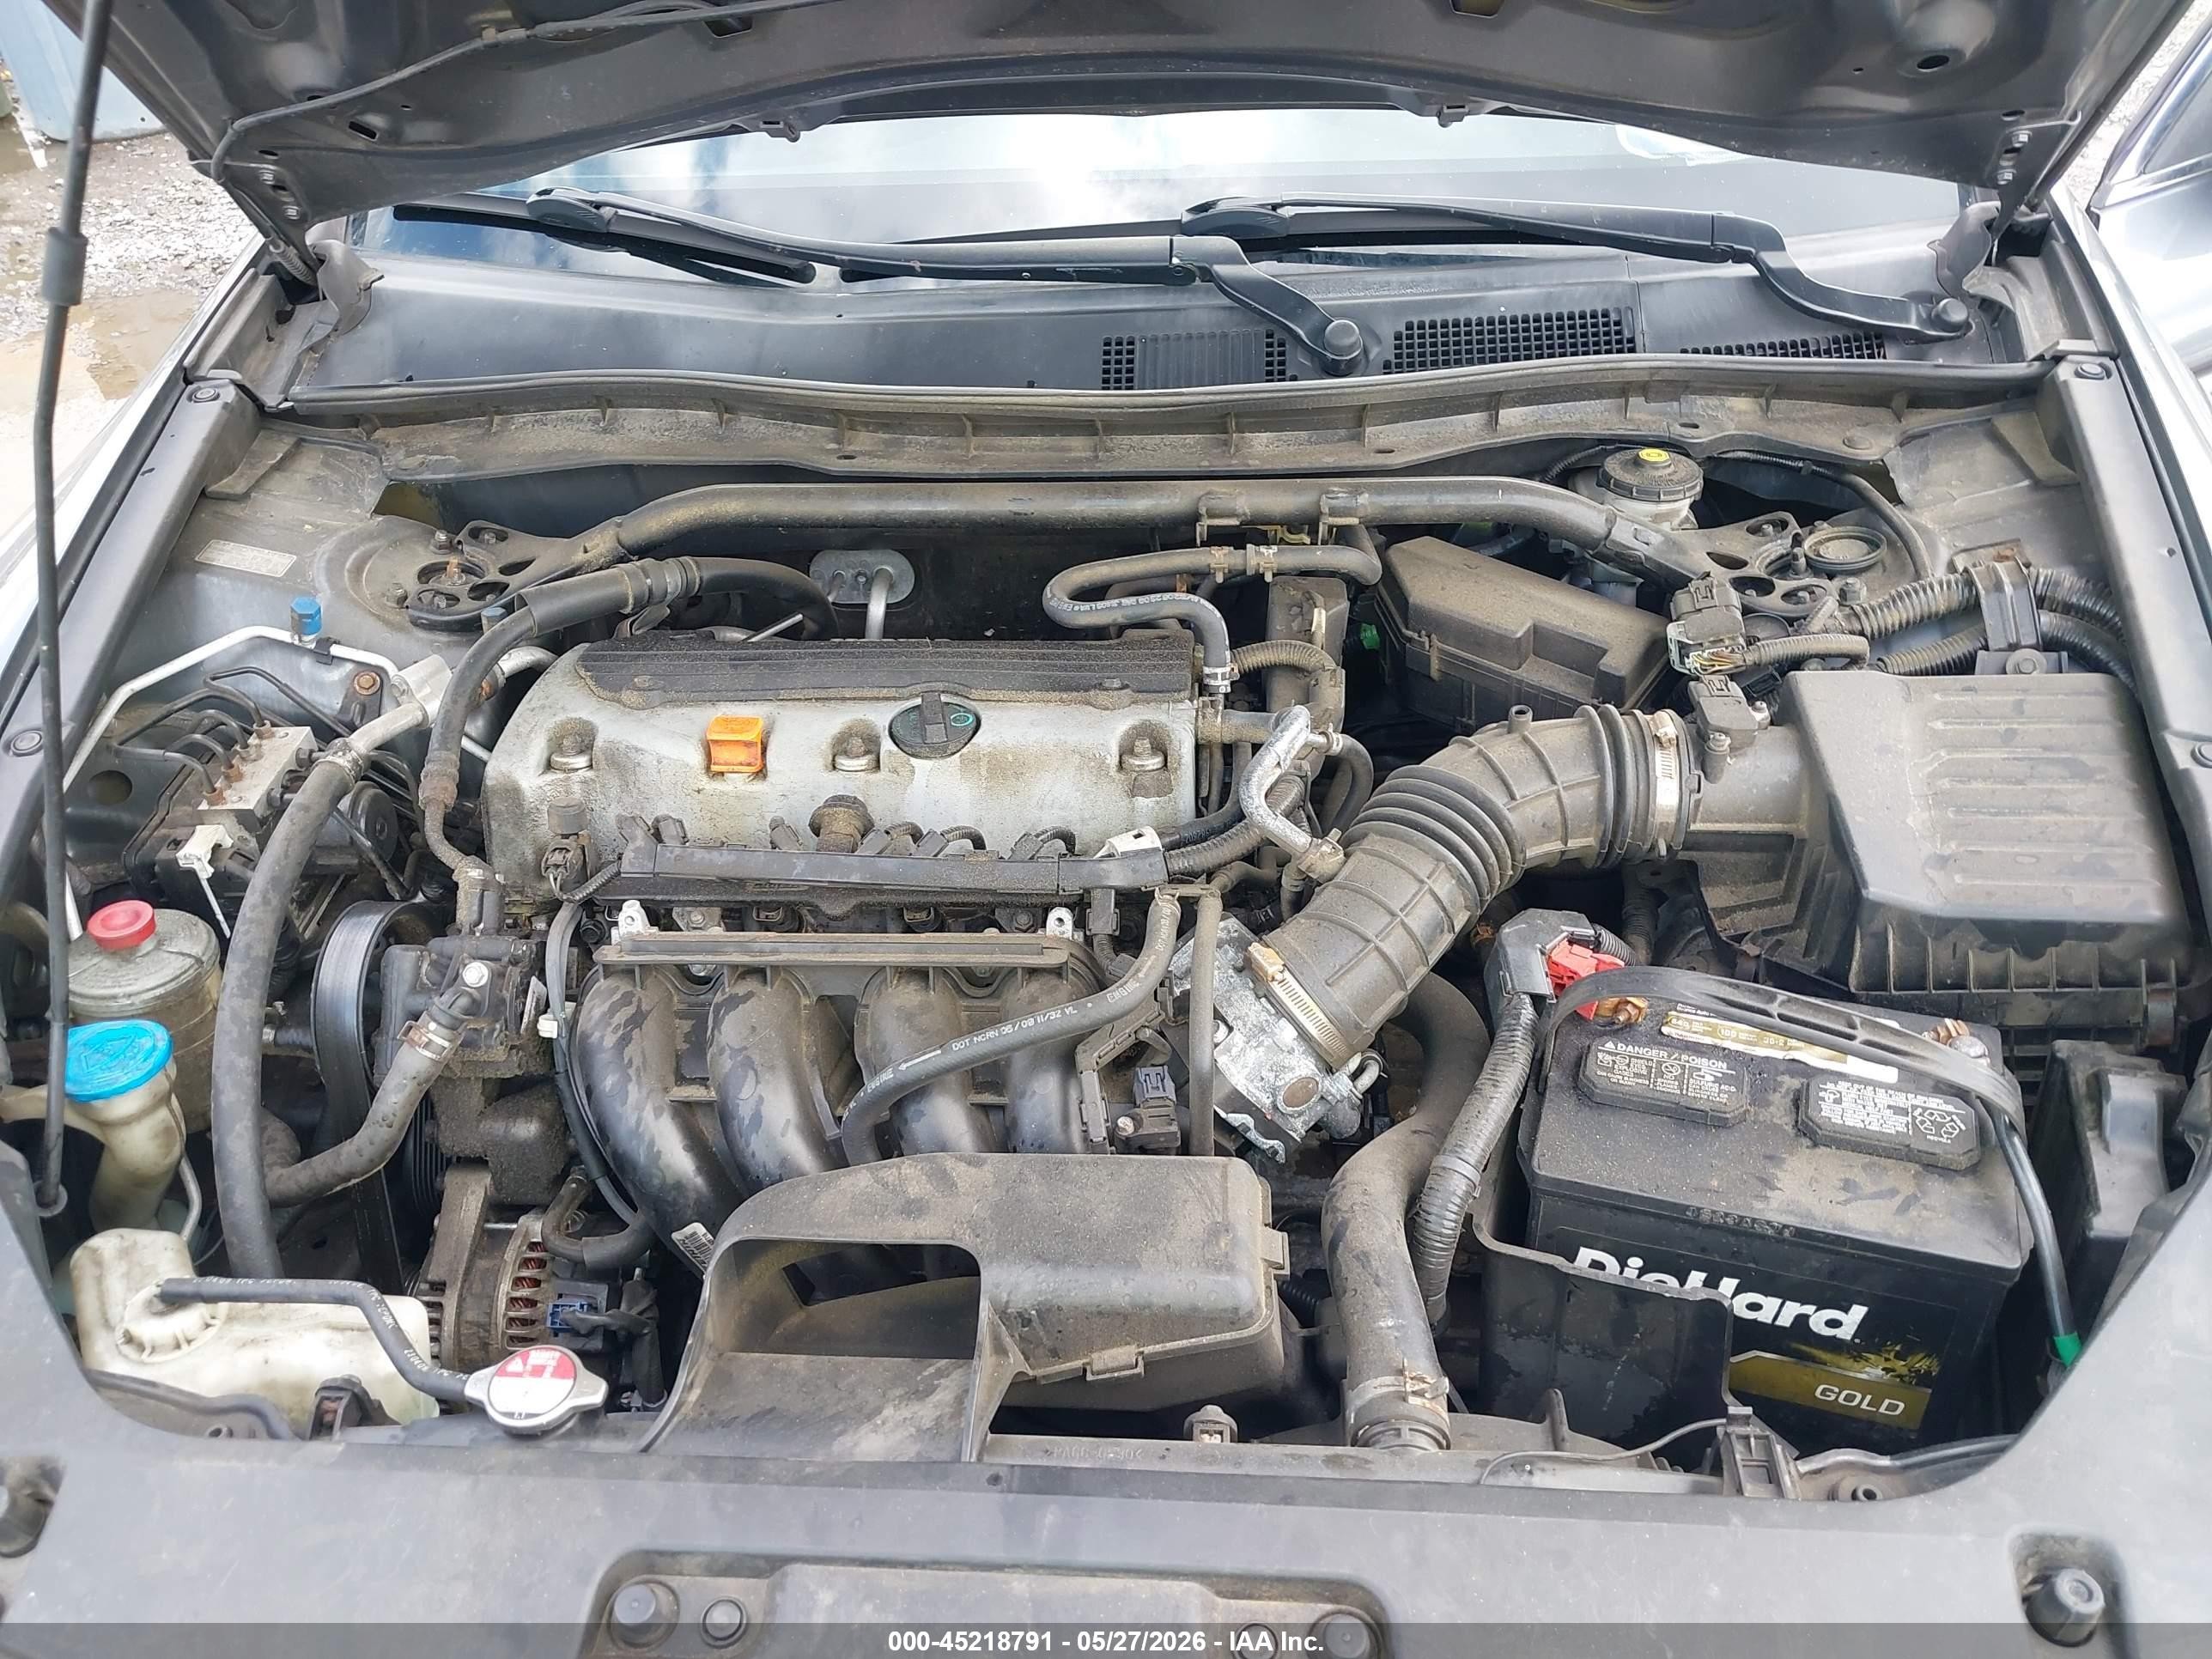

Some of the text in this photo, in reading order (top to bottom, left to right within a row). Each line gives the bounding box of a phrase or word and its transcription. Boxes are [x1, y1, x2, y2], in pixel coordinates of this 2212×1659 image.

[951, 1038, 971, 1052] DOT
[1617, 1042, 1668, 1060] DANGER
[1680, 1054, 1728, 1069] POISON
[1814, 1383, 1905, 1417] GOLD
